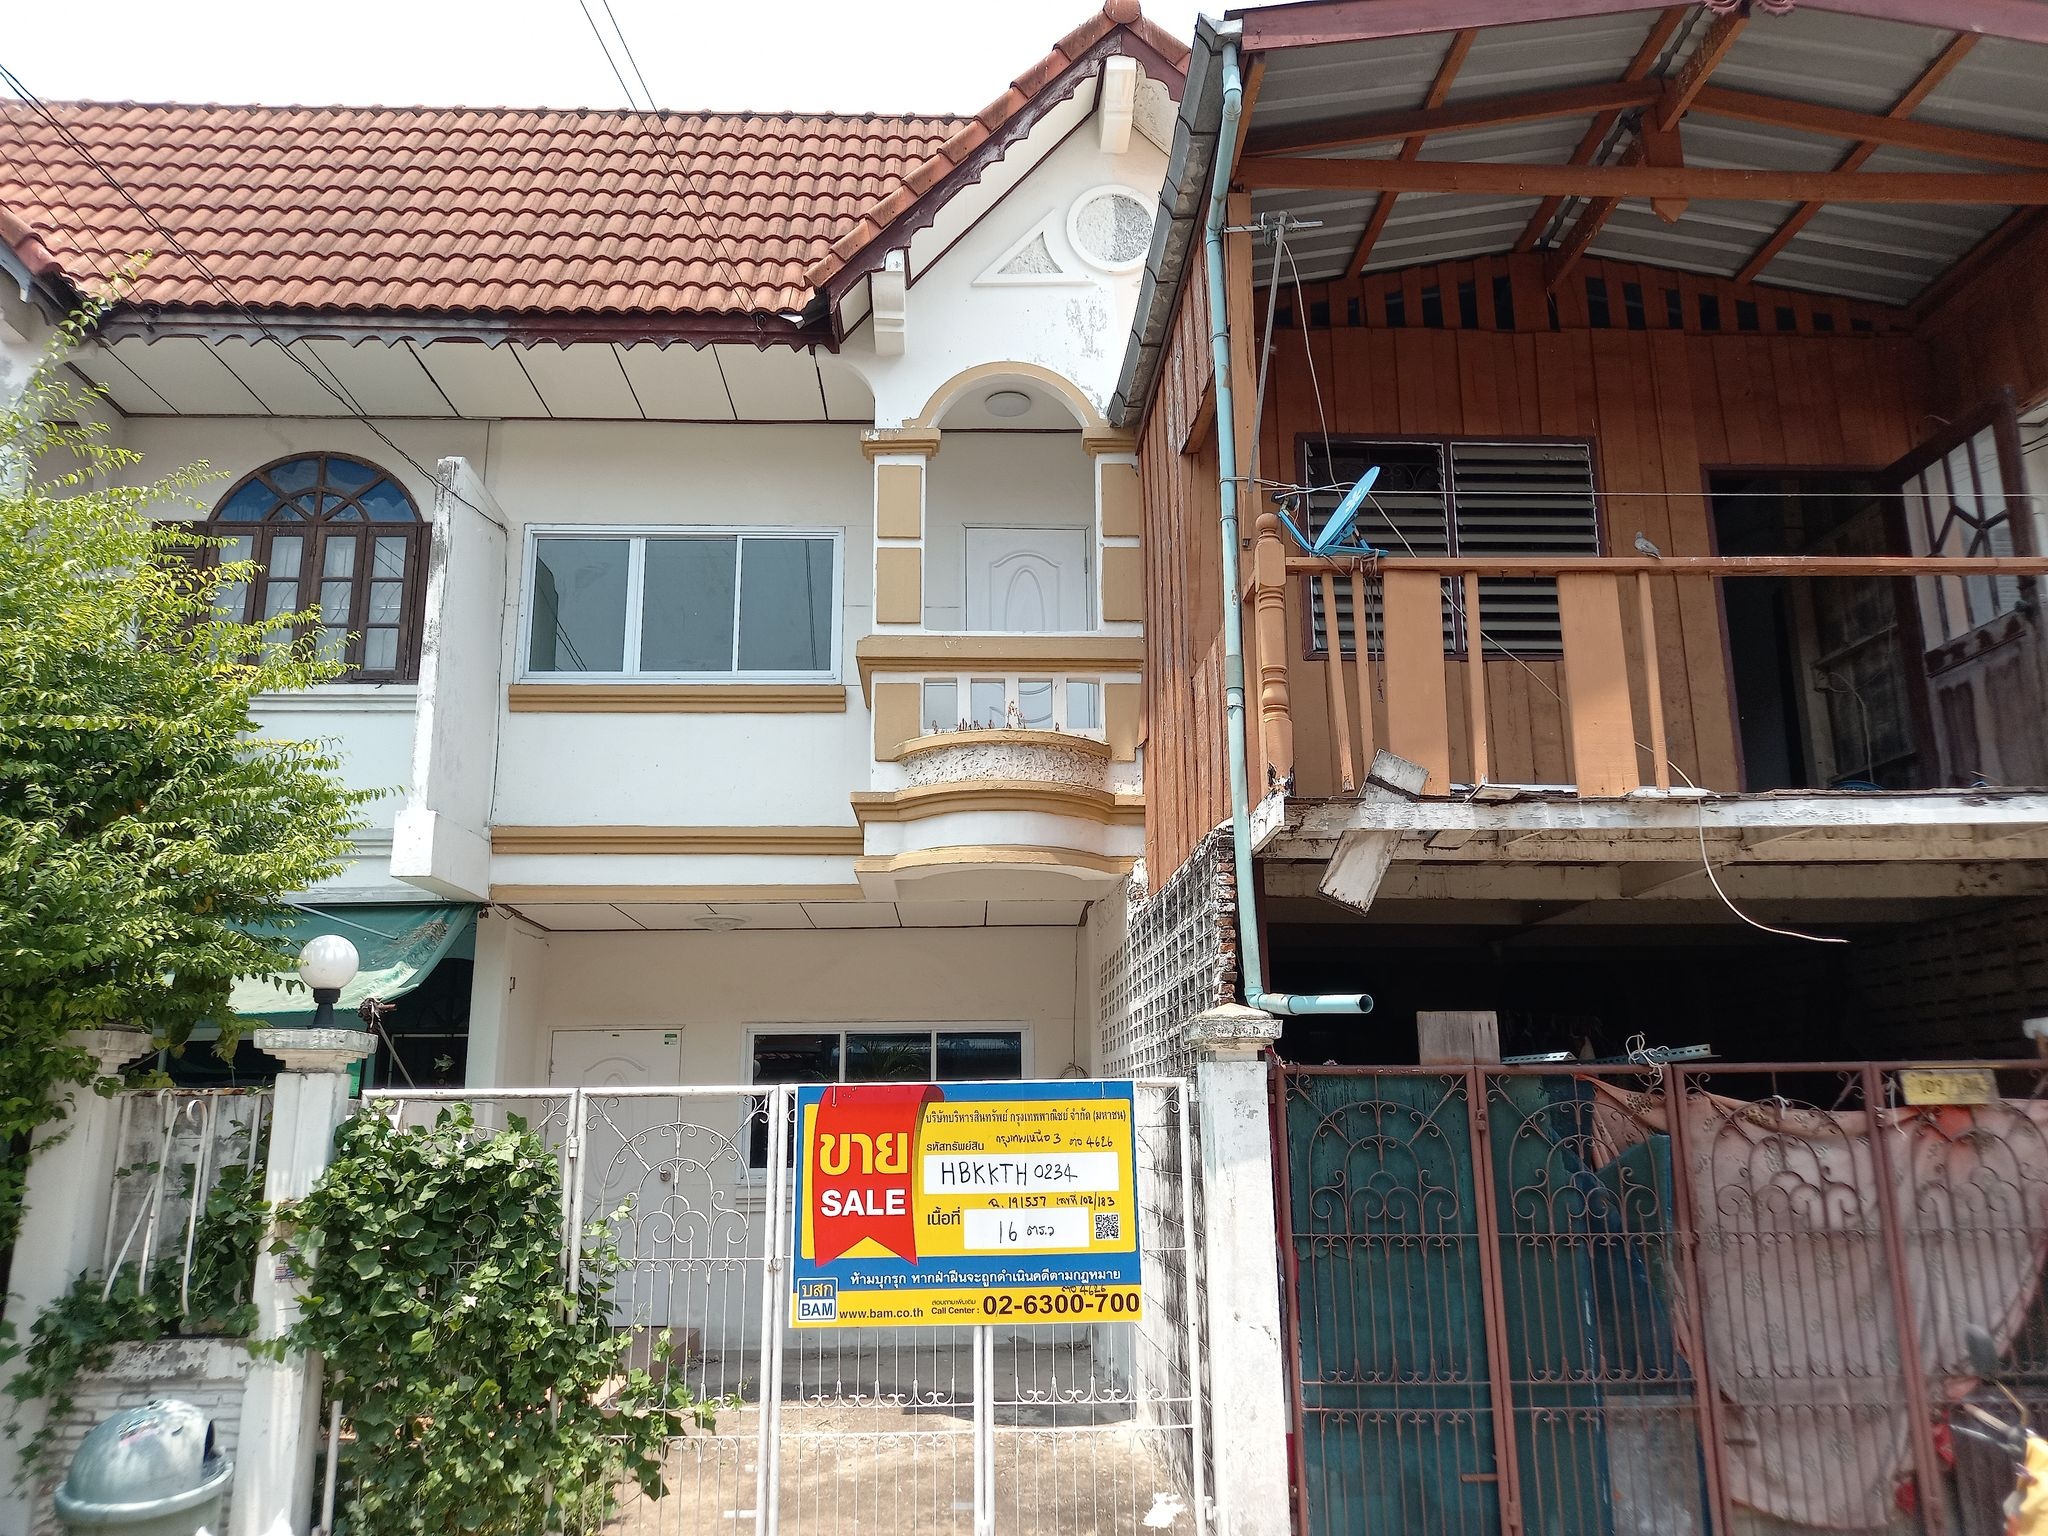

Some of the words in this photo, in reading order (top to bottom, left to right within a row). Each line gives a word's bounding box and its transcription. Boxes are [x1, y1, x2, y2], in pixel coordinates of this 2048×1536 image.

[926, 1109, 1008, 1123] บริษัทบริหารสินทรัพย์
[1010, 1107, 1068, 1126] กรุงเทพพาณิชย์
[1070, 1107, 1090, 1120] จำกัด
[1093, 1110, 1126, 1122] (มหาชน)
[926, 1141, 985, 1151] รหัสทรัพย์สิน
[1053, 1133, 1061, 1144] 3
[1086, 1135, 1113, 1148] 4626
[819, 1132, 908, 1176] ขาย
[941, 1161, 1027, 1186] HBKKTH
[1034, 1163, 1078, 1182] 0234
[820, 1189, 906, 1216] SALE
[1008, 1196, 1047, 1208] 191557
[1080, 1191, 1115, 1210] 102/183
[927, 1206, 961, 1225] เนื้อที่
[850, 1271, 906, 1289] ห้ามบุกรุก
[911, 1268, 1121, 1288] หากฝ่าฝืนจะถูกดำเนินคดีตามกฎหมาย
[801, 1283, 833, 1297] บสก
[801, 1302, 833, 1317] BAM
[839, 1307, 923, 1319] www.bam.co.th
[931, 1306, 947, 1315] Call
[982, 1292, 1140, 1316] 02-6300-700
